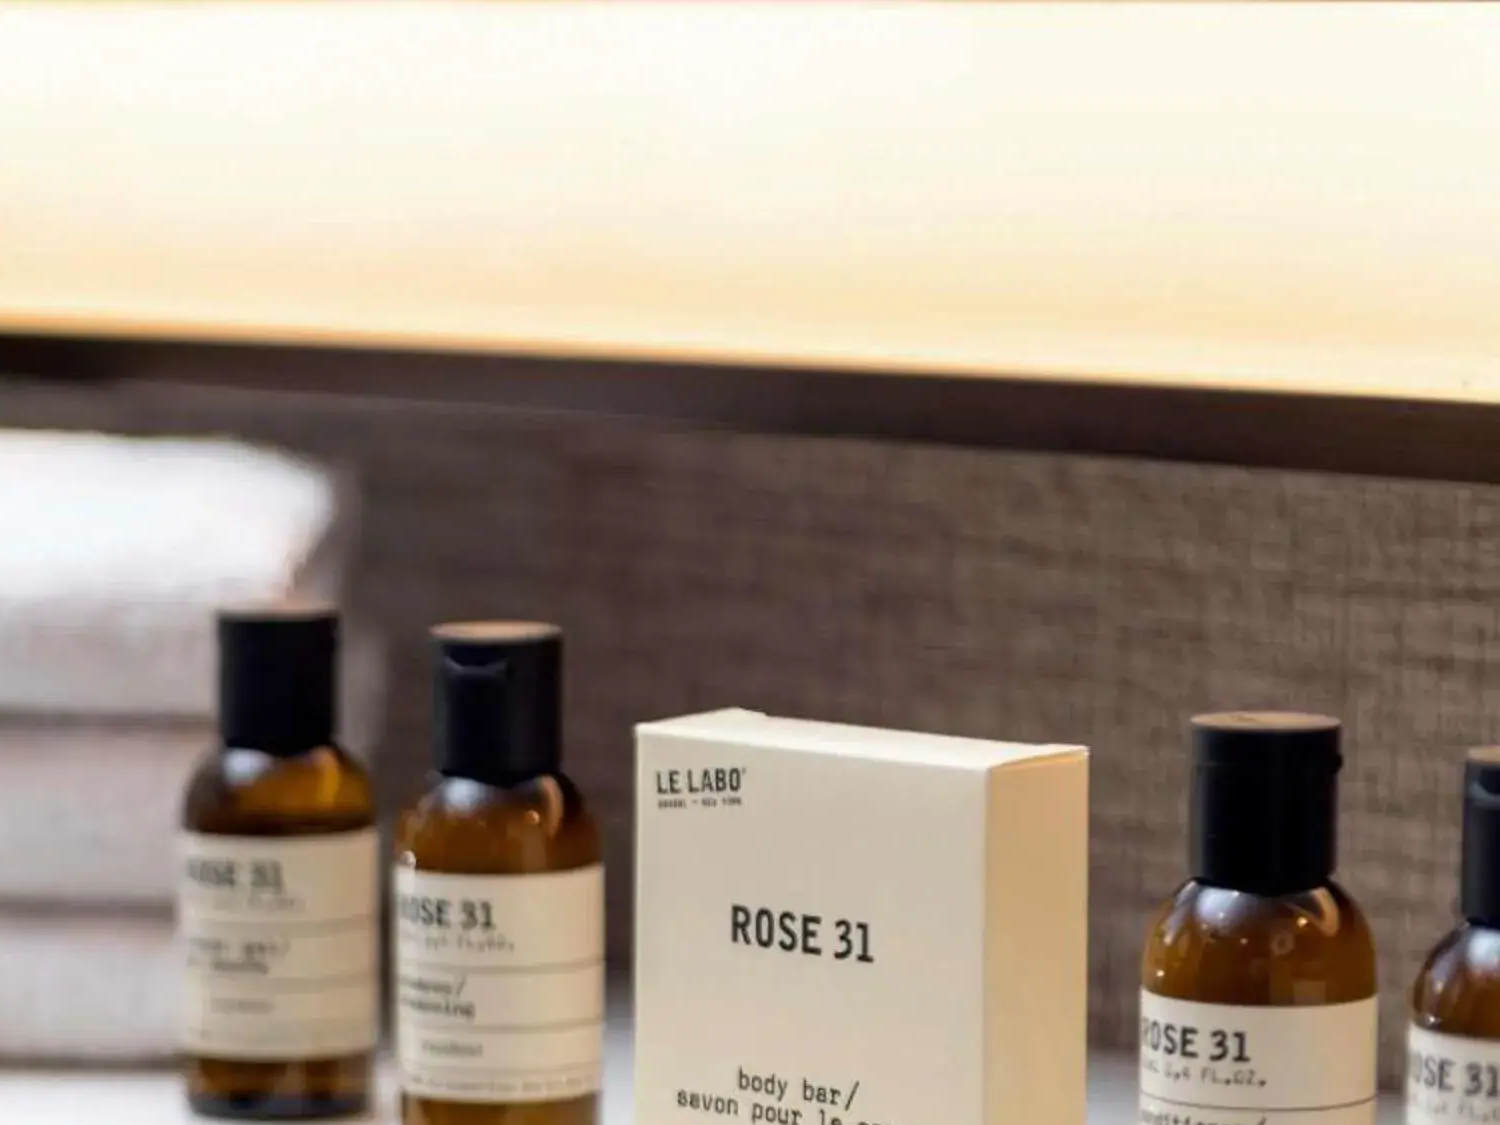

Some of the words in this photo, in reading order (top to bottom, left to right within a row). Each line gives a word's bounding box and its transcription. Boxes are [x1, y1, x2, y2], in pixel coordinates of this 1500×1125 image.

[656, 769, 681, 794] LE
[731, 903, 823, 956] ROSE
[833, 918, 875, 964] 31
[1208, 1028, 1252, 1063] 31
[676, 1088, 740, 1117] savon
[738, 1066, 788, 1102] body
[802, 1078, 860, 1111] bar/
